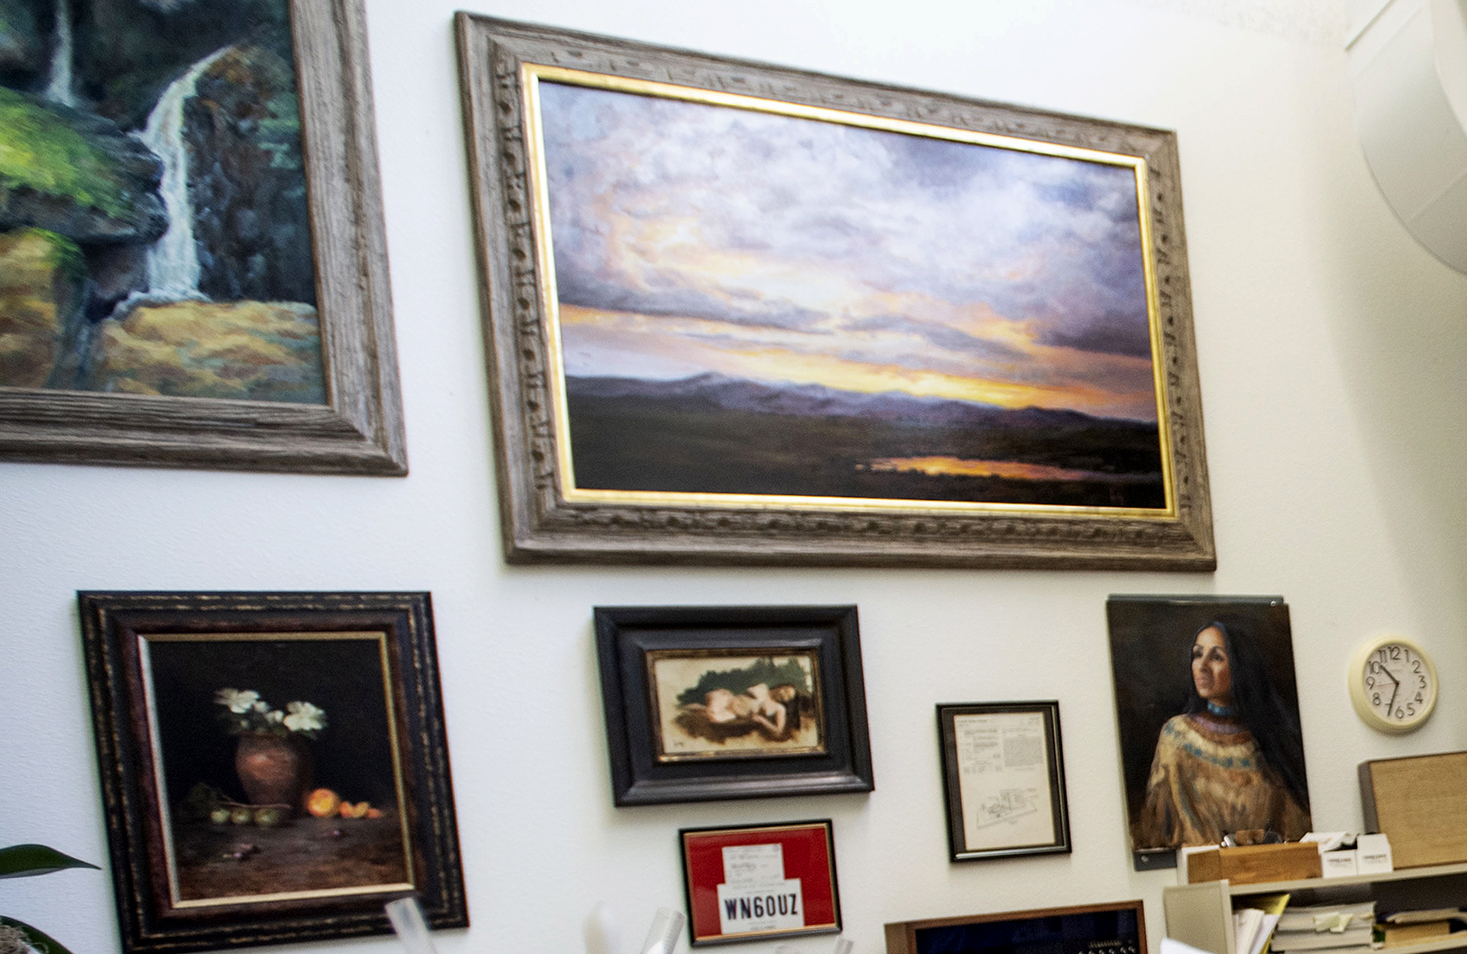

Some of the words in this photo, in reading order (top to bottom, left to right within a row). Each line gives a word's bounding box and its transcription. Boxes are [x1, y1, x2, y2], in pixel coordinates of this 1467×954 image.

[1378, 649, 1387, 663] 11
[1388, 646, 1400, 660] 12
[1404, 649, 1409, 662] 1
[1368, 661, 1380, 674] 10
[1412, 660, 1421, 673] 2
[1366, 676, 1375, 690] 9
[1418, 675, 1427, 689] 3
[1373, 692, 1381, 706] 8
[1415, 692, 1424, 704] 4
[1395, 706, 1404, 719] 6
[1407, 703, 1415, 716] 5
